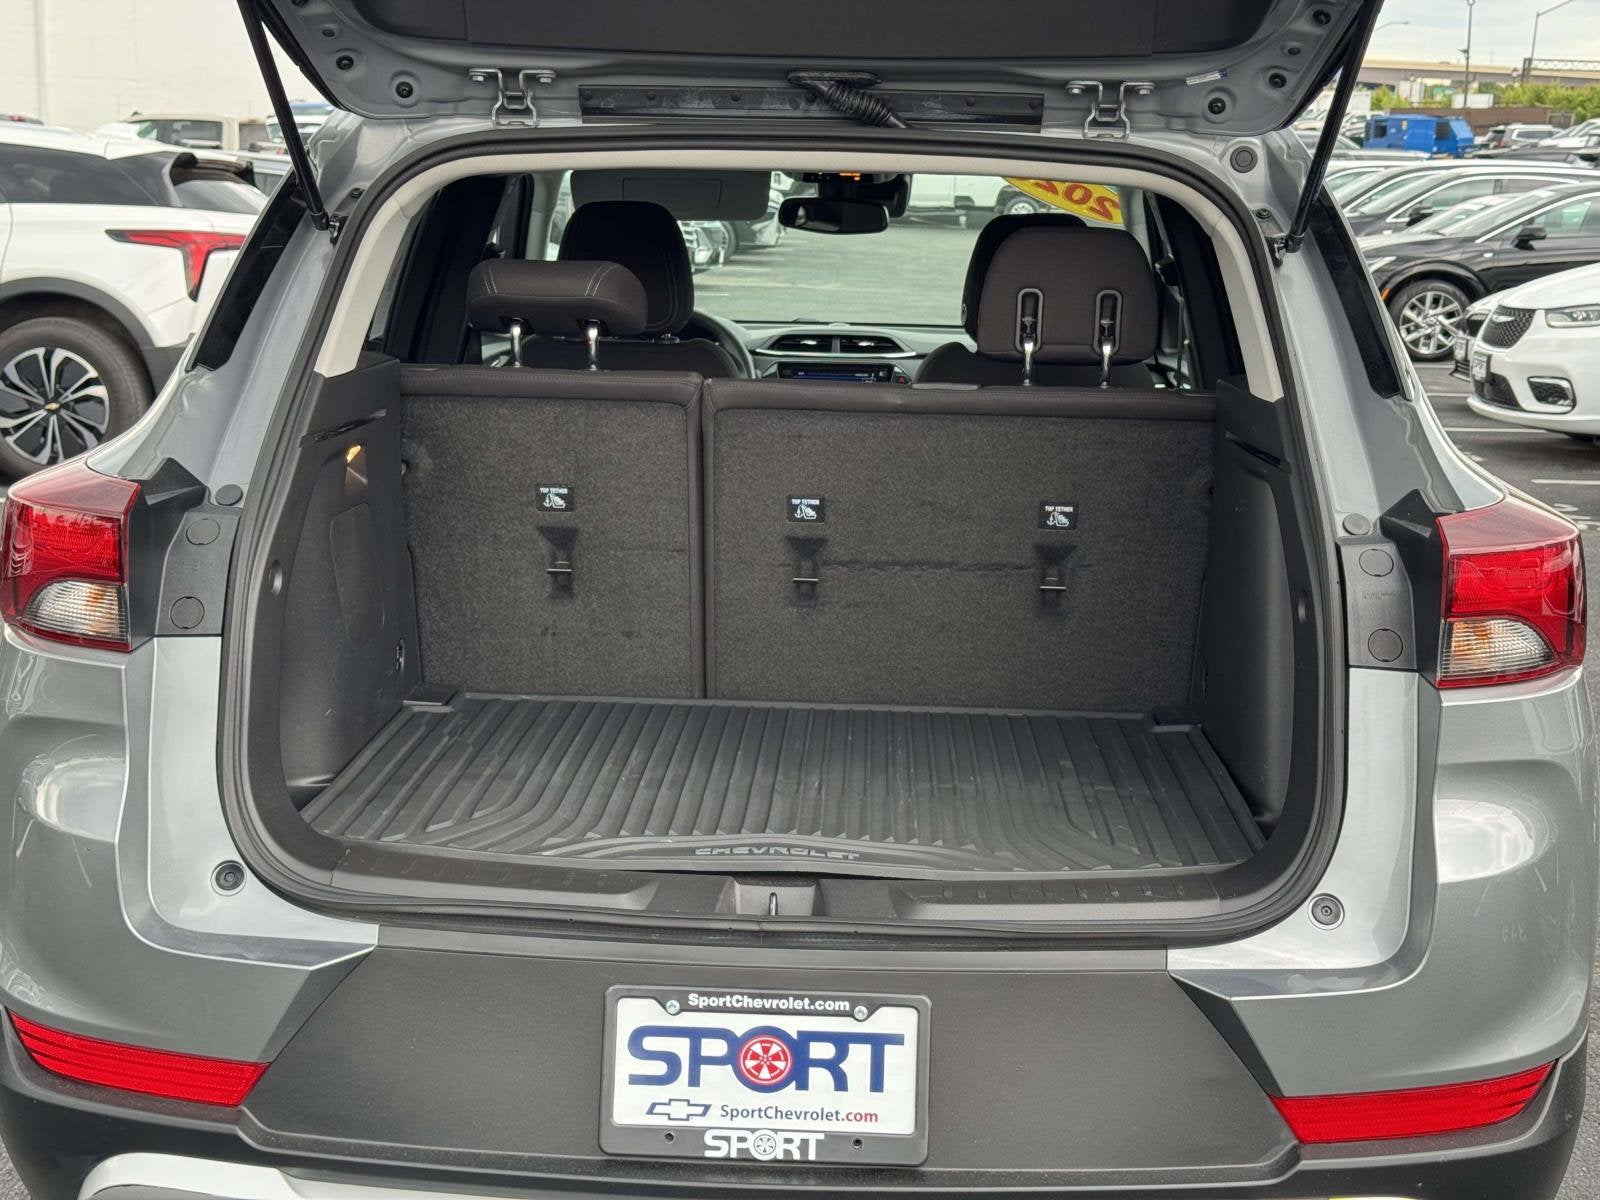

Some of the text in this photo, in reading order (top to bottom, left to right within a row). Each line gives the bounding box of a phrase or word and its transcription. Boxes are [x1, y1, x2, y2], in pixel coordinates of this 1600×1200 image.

[695, 846, 860, 860] CHEVROLET
[688, 993, 849, 1011] SportChevrolet.com
[627, 1025, 904, 1093] SPORT
[720, 1104, 878, 1123] SportChevrolet.com
[703, 1129, 825, 1161] SPORT
